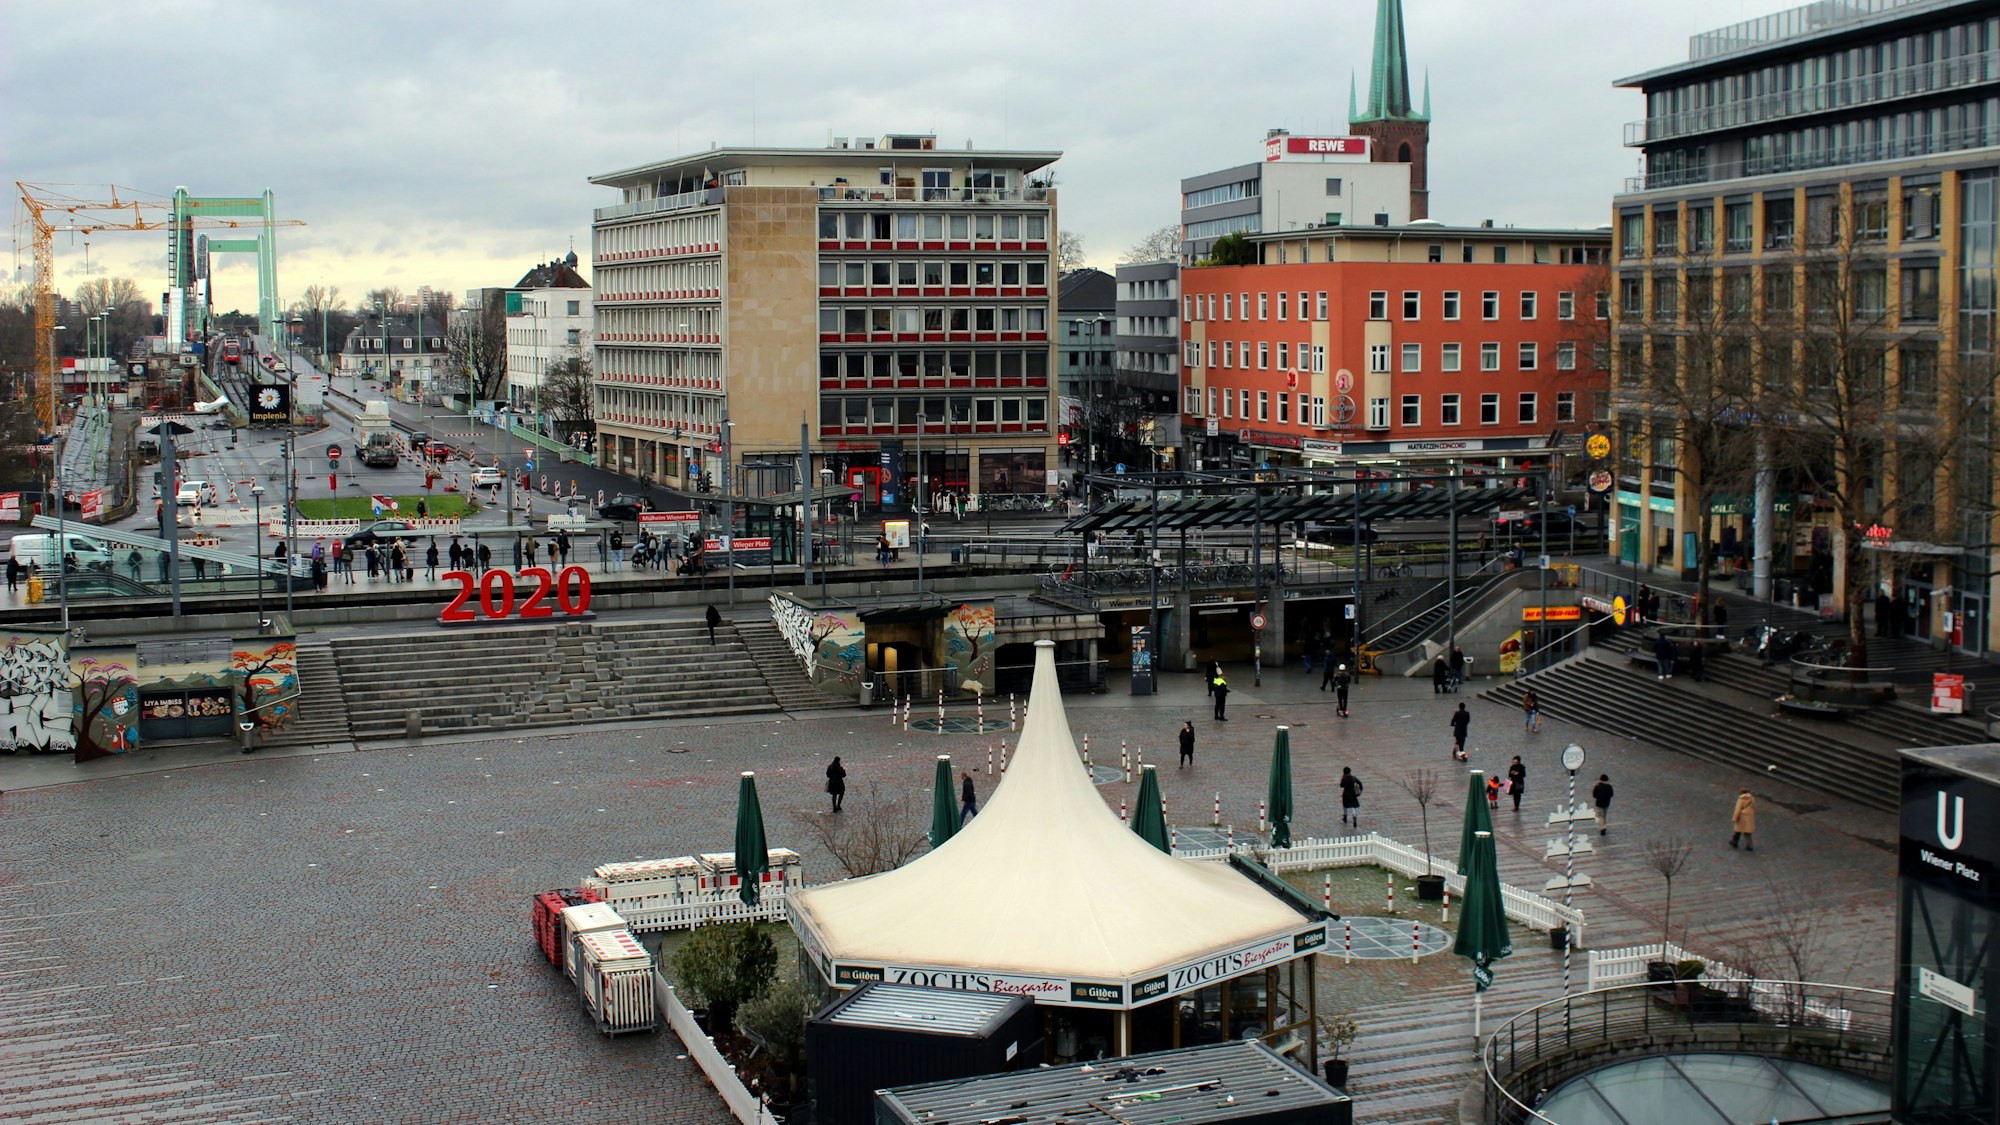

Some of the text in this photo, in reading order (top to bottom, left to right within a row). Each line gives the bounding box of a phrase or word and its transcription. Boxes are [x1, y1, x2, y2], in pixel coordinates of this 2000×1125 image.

[1267, 143, 1280, 157] REWE
[1309, 140, 1345, 152] REWE
[253, 412, 287, 420] Implenia
[440, 566, 591, 621] 2020
[1162, 596, 1170, 605] U
[160, 698, 183, 706] IMBISS
[1937, 790, 1964, 851] U
[1920, 848, 1980, 882] Wiener Platz
[1304, 931, 1324, 945] Gilden
[1174, 940, 1290, 989] ZOCH'S Biergarten
[852, 970, 880, 981] Gilden
[893, 970, 1063, 995] ZOCH'S Biergarten
[1088, 987, 1118, 998] Gilden
[1144, 979, 1166, 994] Gilden
